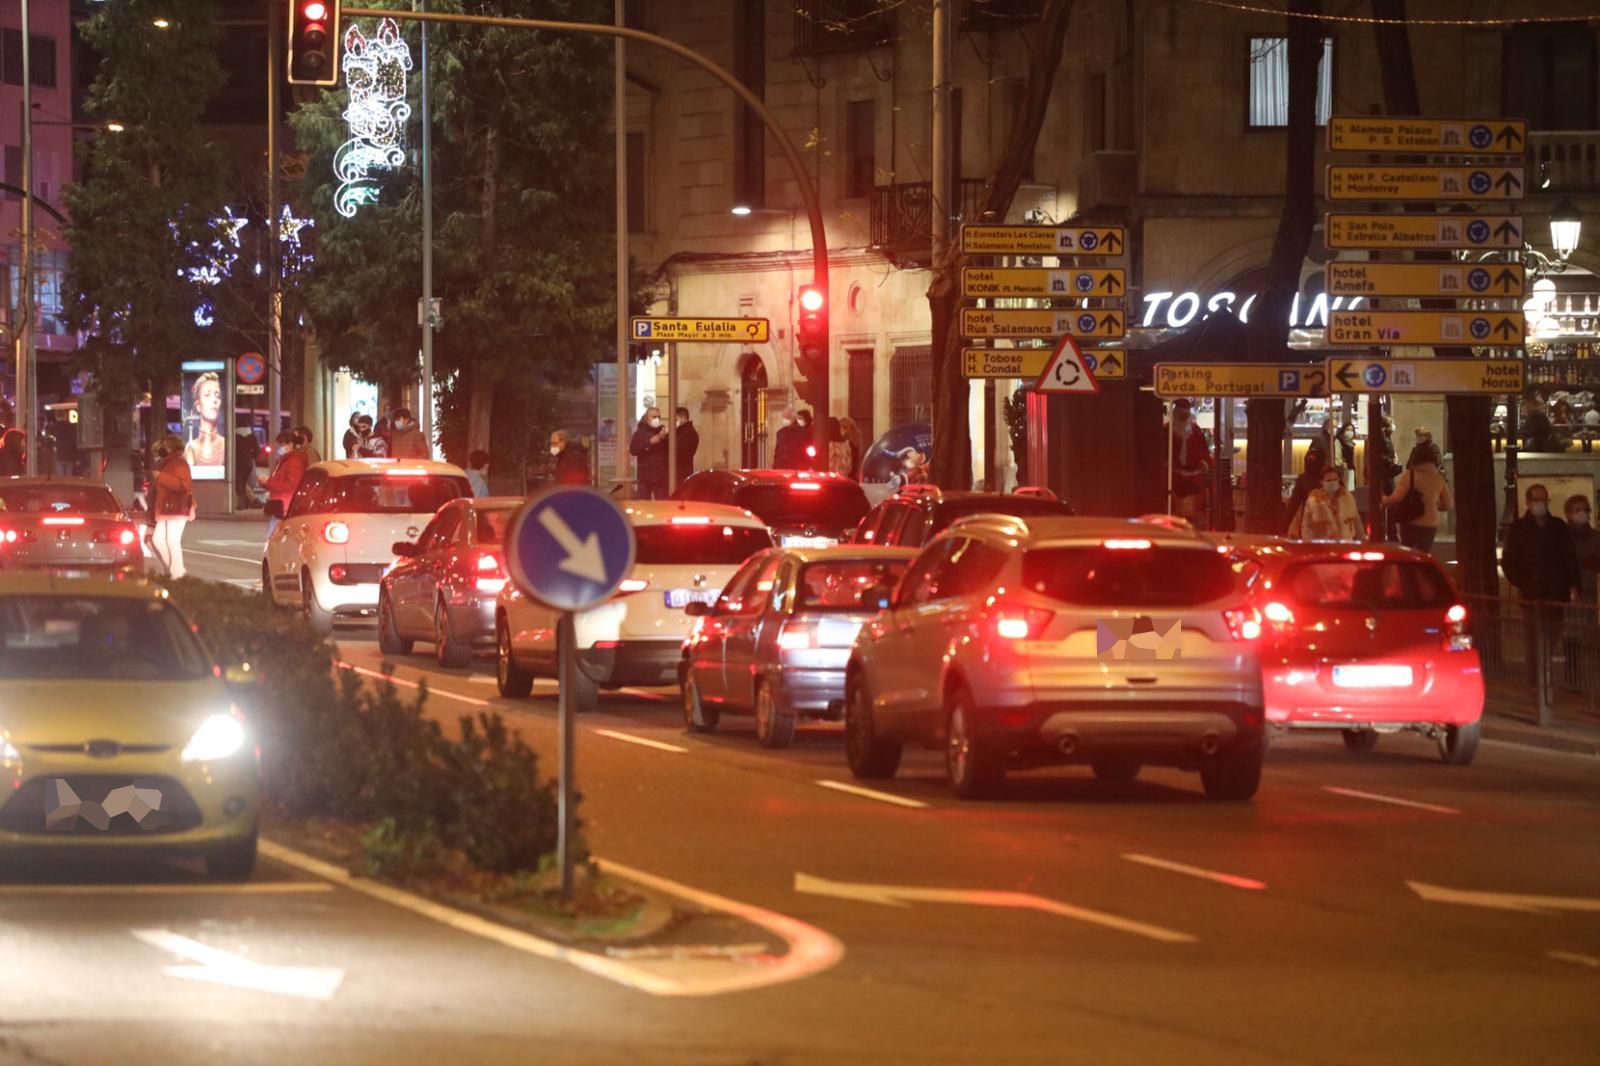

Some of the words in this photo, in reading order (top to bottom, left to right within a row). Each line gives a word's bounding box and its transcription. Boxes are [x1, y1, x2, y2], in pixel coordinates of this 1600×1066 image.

[1347, 184, 1399, 195] Monterrey
[1348, 221, 1367, 231] San
[1371, 221, 1395, 231] Polo
[1347, 231, 1387, 241] Estrella
[1392, 231, 1436, 241] Albatros
[967, 272, 994, 281] hotel
[1333, 267, 1367, 278] hotel
[1334, 280, 1375, 291] Amefa
[966, 313, 995, 323] hotel
[1334, 315, 1371, 326] hotel
[653, 321, 688, 331] Santa
[696, 322, 736, 331] Eulalia
[992, 324, 1052, 334] Salamanca
[1335, 328, 1371, 339] Gran
[983, 354, 1022, 363] Toboso
[983, 364, 1021, 373] Condal
[1486, 364, 1520, 375] hotel
[1161, 368, 1212, 380] Parking
[1206, 381, 1264, 393] Portugal
[1482, 378, 1520, 388] Horus
